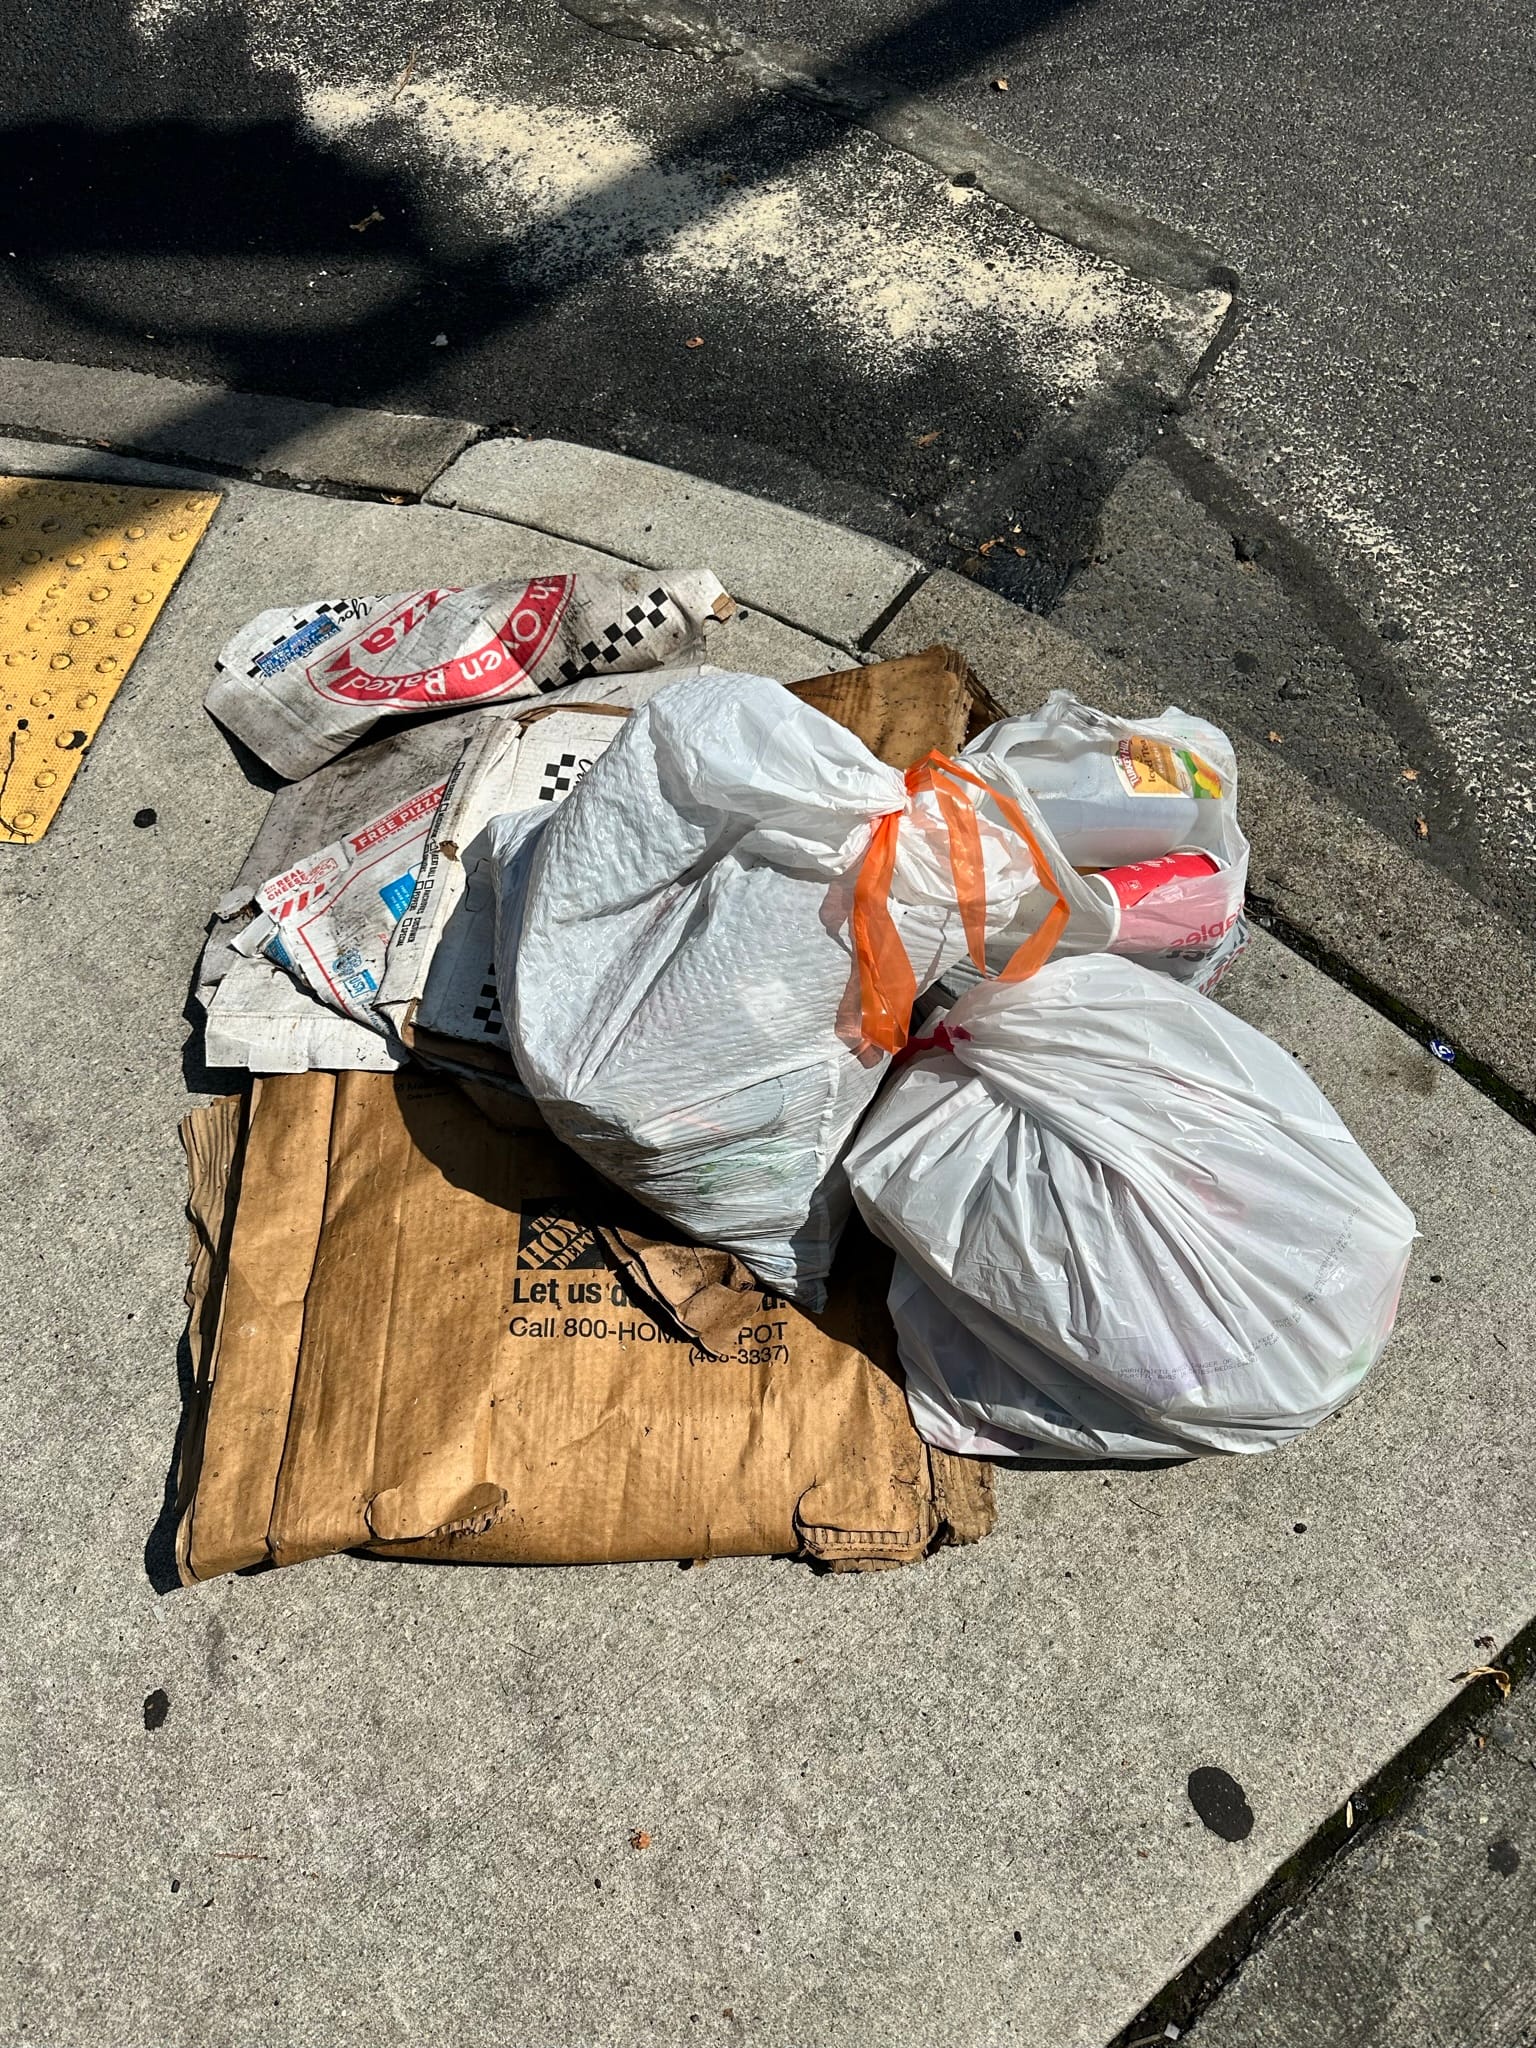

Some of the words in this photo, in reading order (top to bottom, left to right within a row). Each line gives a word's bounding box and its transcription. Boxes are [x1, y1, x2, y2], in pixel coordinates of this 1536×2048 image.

[360, 588, 458, 653] zza
[458, 608, 542, 680] Oven
[348, 667, 447, 696] Baked
[358, 820, 397, 847] FREE
[276, 869, 304, 887] REAL
[349, 977, 366, 994] USA
[518, 1218, 582, 1269] HOM
[552, 1230, 597, 1269] DEPO
[513, 1278, 560, 1304] Let
[567, 1281, 601, 1304] us
[509, 1317, 555, 1339] Call
[564, 1318, 698, 1344] 800-HOM
[734, 1322, 788, 1346] POT
